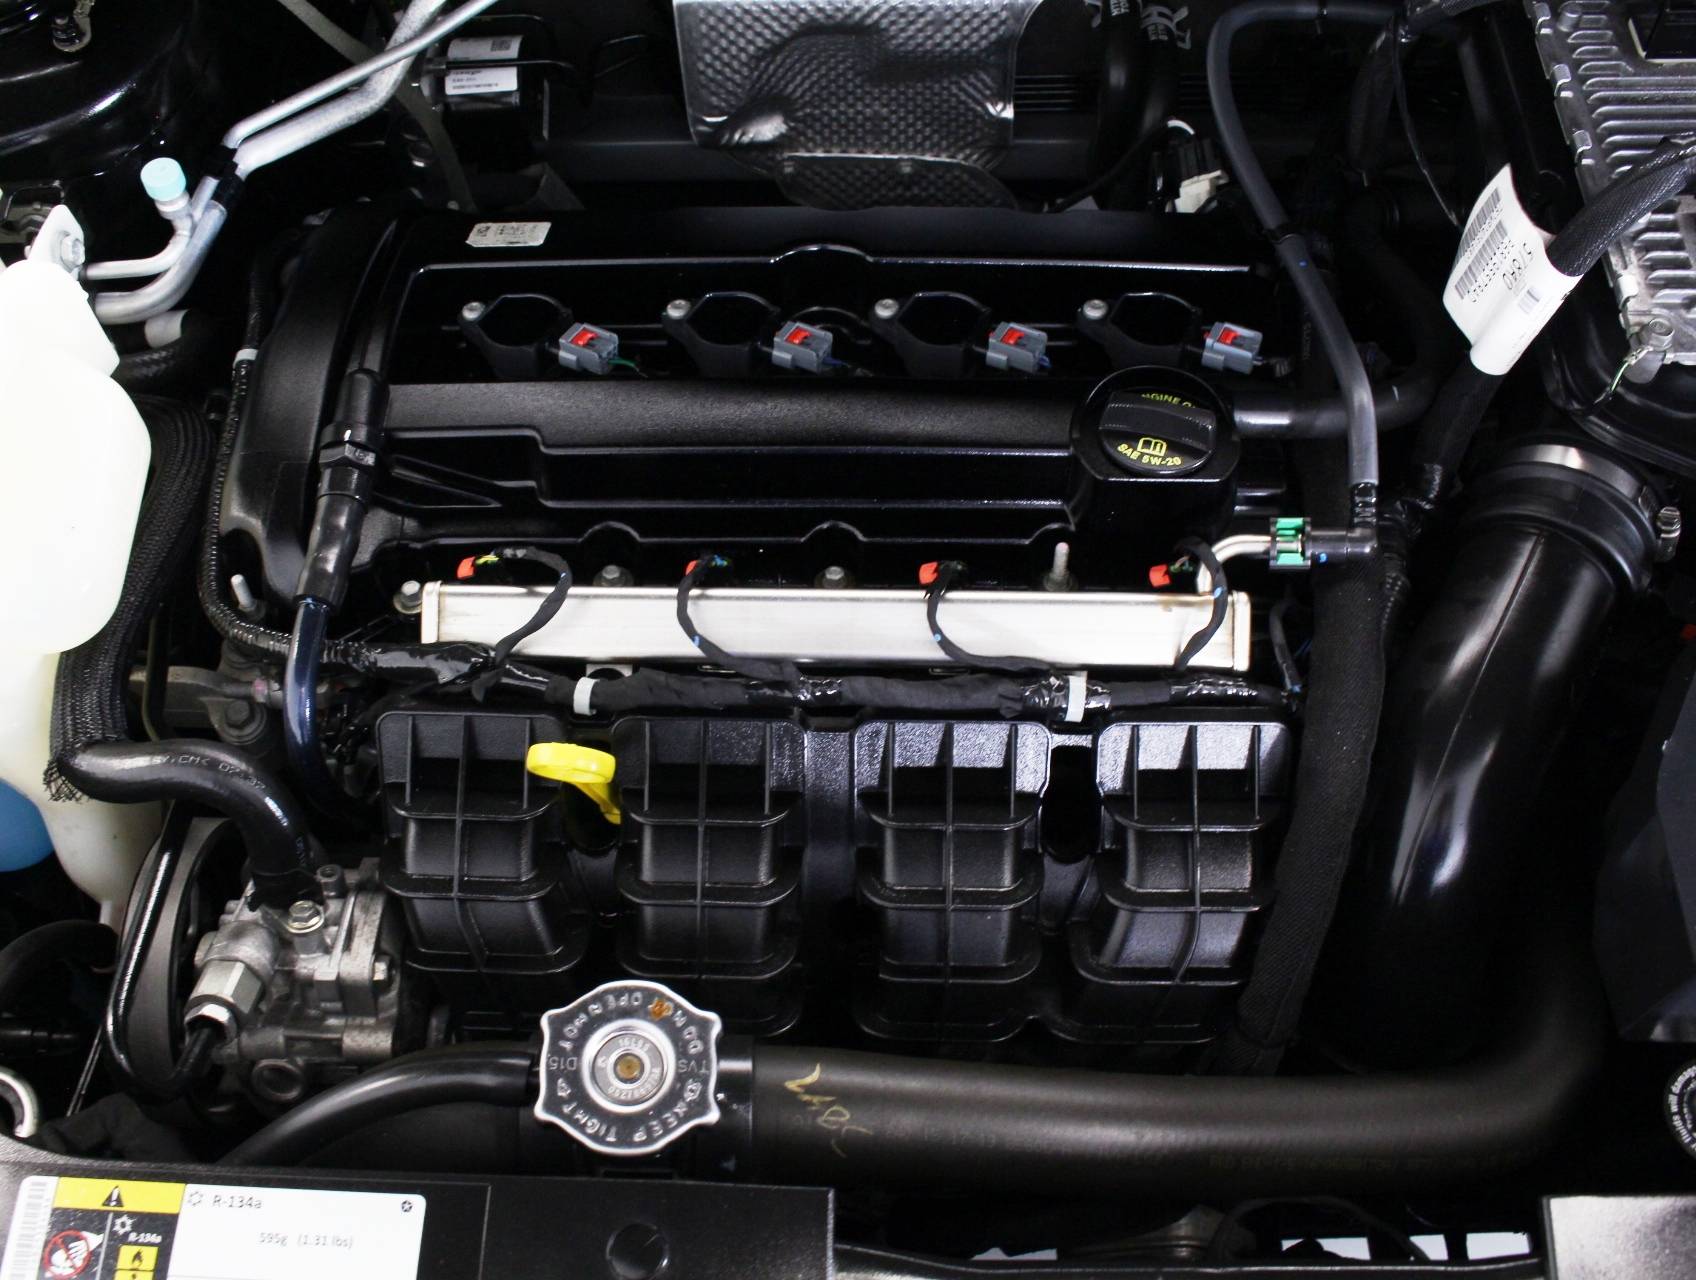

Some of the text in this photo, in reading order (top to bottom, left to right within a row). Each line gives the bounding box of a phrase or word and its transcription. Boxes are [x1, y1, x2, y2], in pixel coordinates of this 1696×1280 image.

[1117, 443, 1182, 467] SAE 5W-20
[588, 991, 644, 1014] OPEN
[677, 1059, 711, 1074] TVS
[562, 1100, 689, 1143] KEEP TIGHT
[212, 1194, 263, 1210] R-134a
